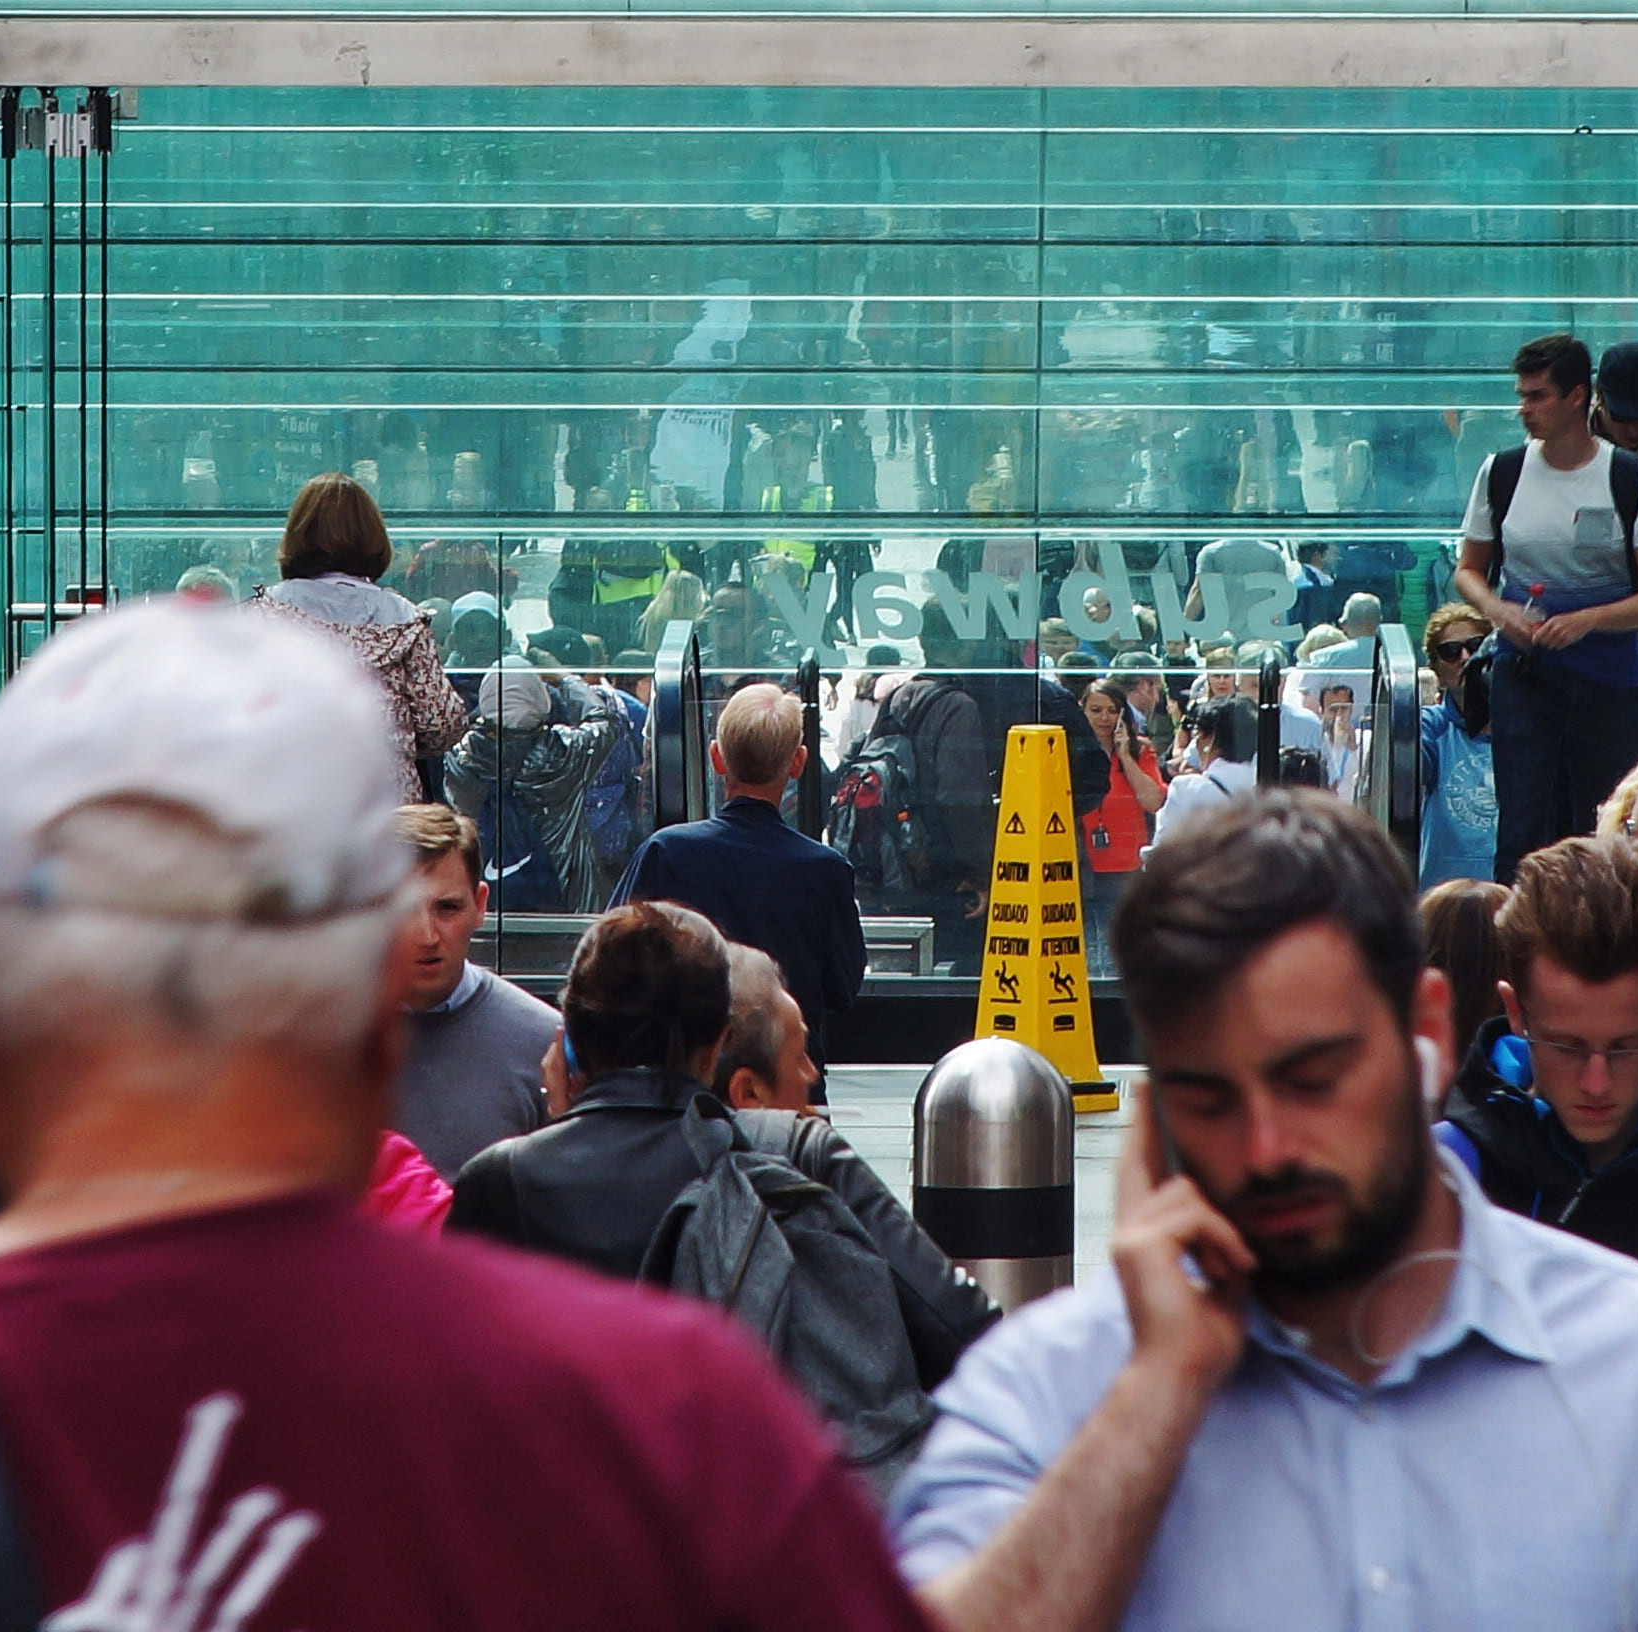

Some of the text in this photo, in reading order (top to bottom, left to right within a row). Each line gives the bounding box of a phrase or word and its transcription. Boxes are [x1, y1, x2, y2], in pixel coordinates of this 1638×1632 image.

[997, 861, 1030, 882] CAUTION
[1042, 861, 1073, 883] CAUTION
[993, 903, 1028, 924] CUIDADO
[1041, 902, 1076, 924] CUIDADO
[988, 936, 1030, 957] ATTENTION
[1041, 936, 1080, 957] ATTENTION
